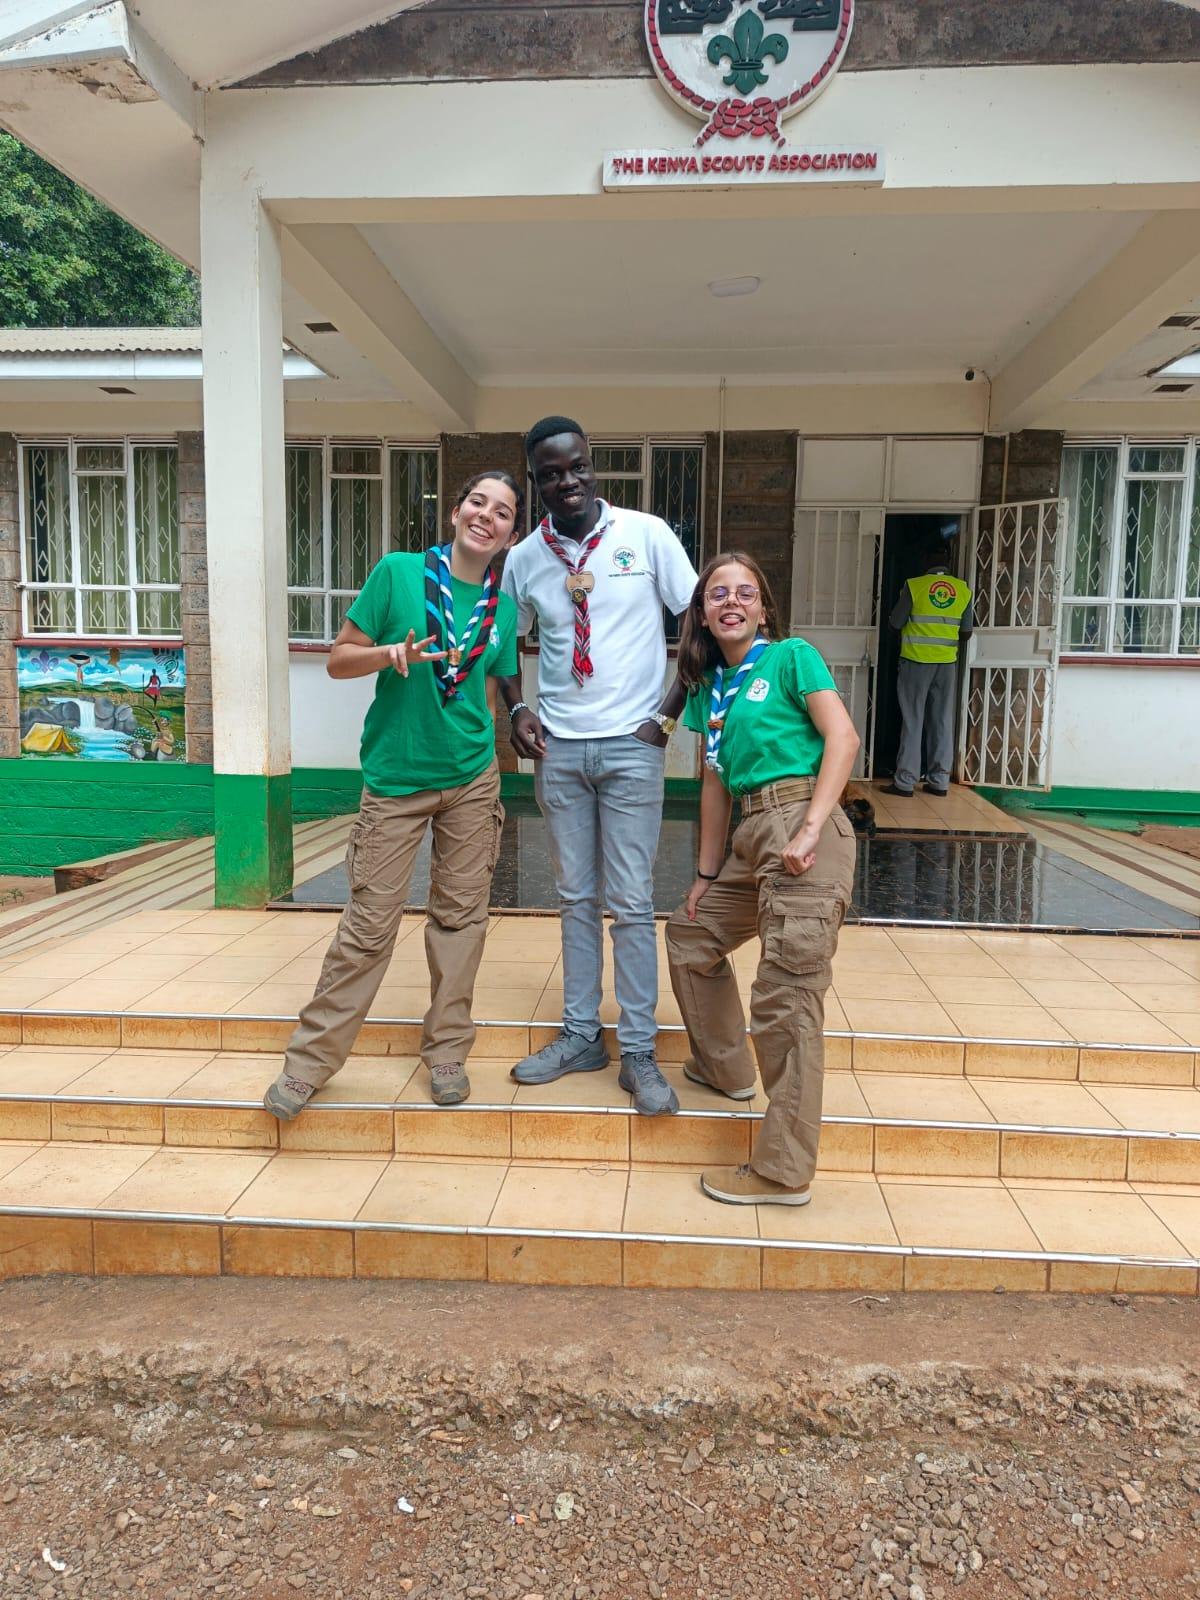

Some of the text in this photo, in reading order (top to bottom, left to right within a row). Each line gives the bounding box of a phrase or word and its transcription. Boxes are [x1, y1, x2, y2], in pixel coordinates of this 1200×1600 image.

[613, 153, 877, 174] THE KENYA SCOUTS ASSOCIATION
